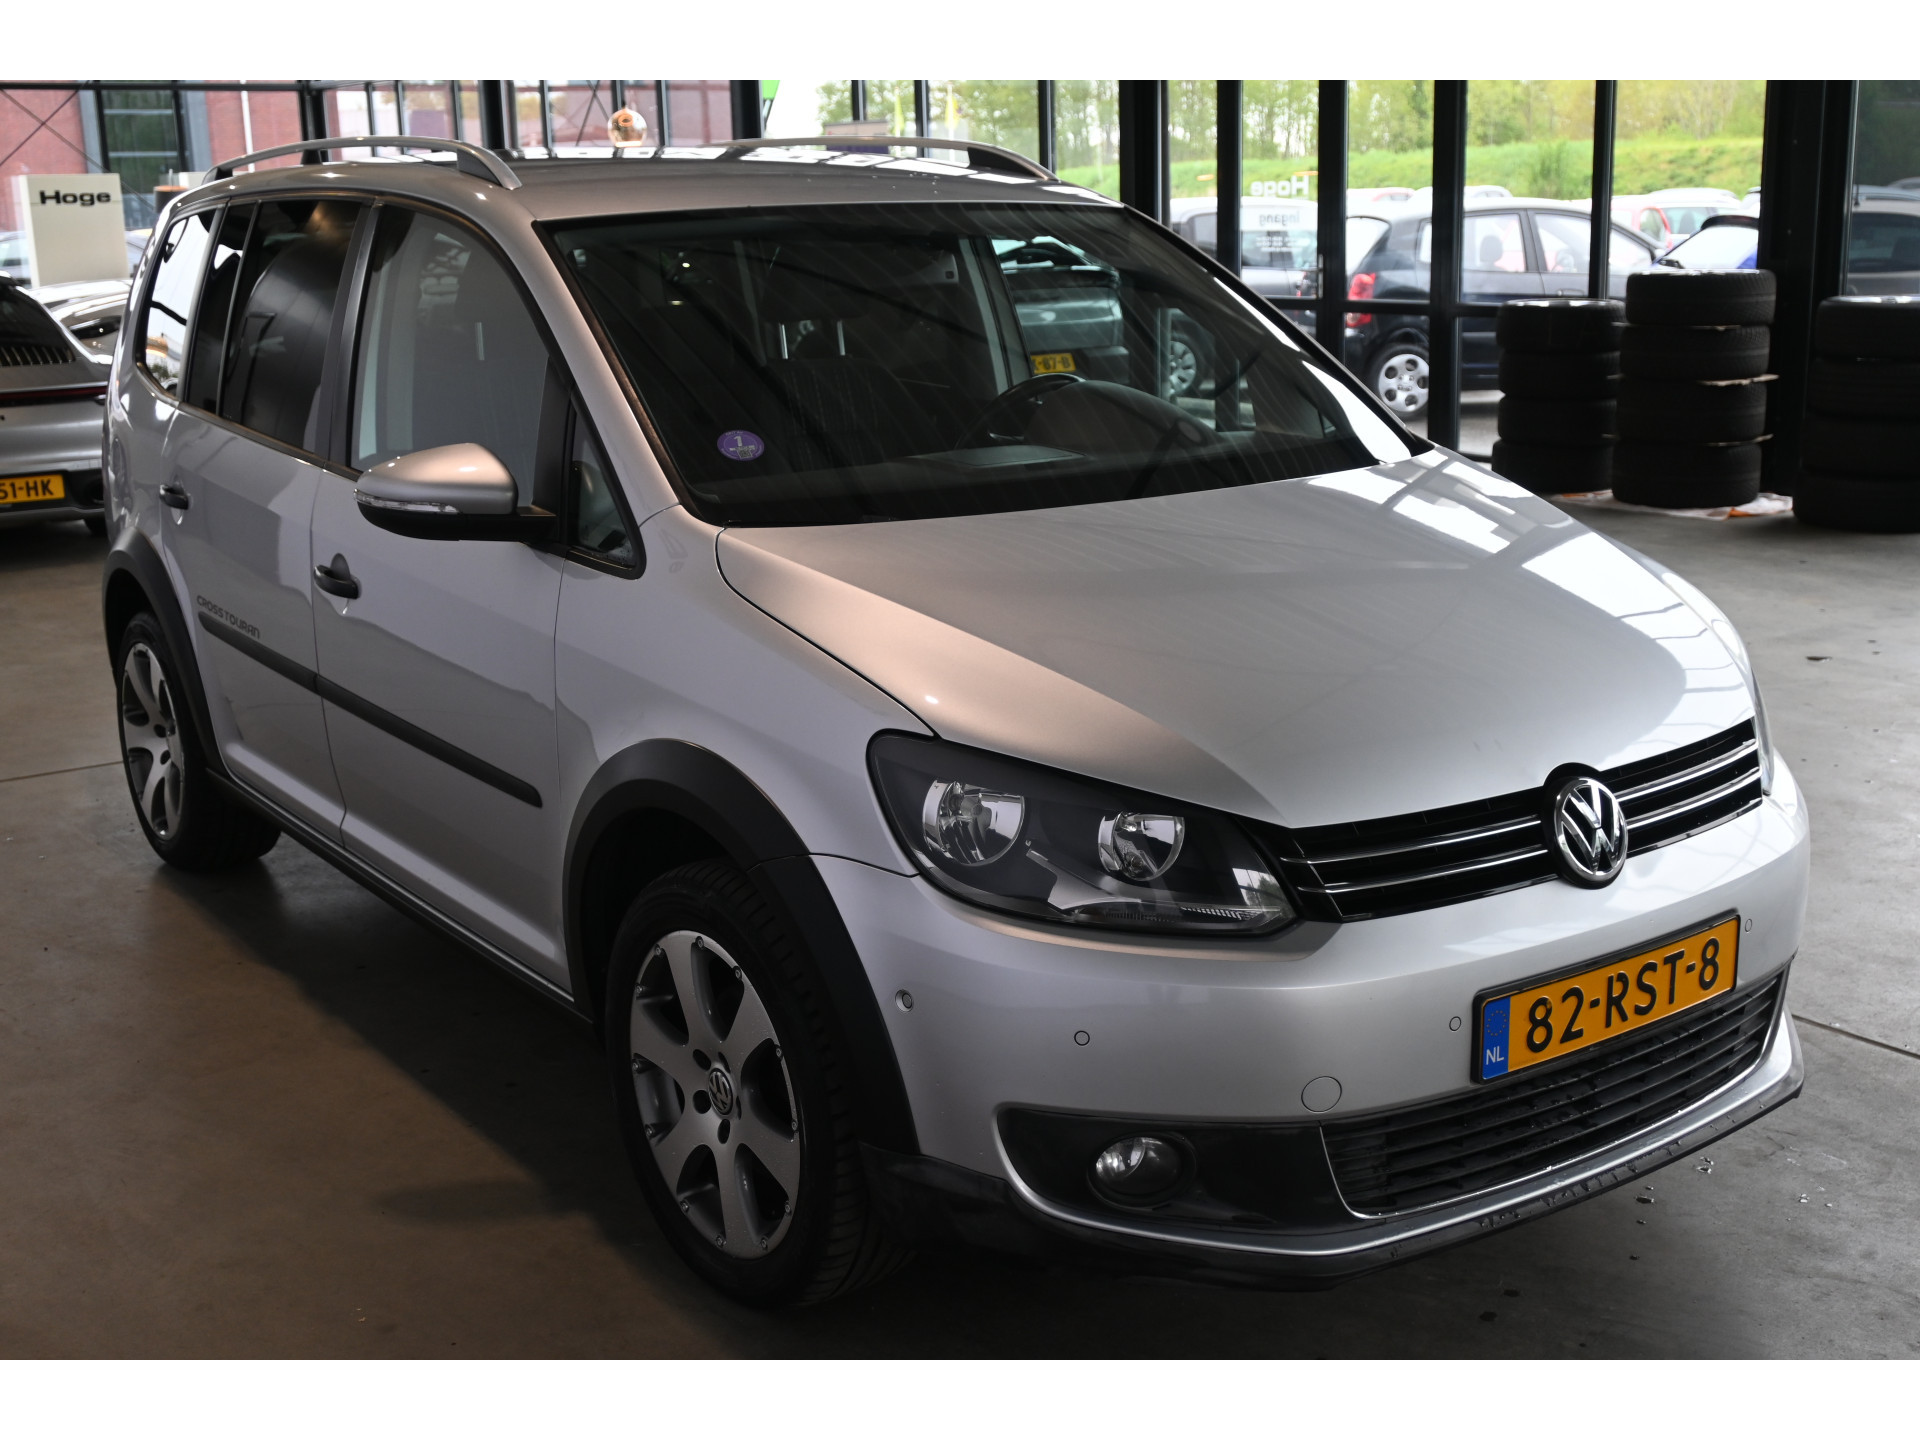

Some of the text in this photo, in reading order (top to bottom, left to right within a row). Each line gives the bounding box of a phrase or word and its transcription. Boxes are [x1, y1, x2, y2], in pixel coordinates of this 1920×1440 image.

[39, 190, 111, 206] Hoge
[733, 435, 743, 447] 1
[1526, 936, 1720, 1053] 82-RST-8
[1485, 1045, 1505, 1065] NL
